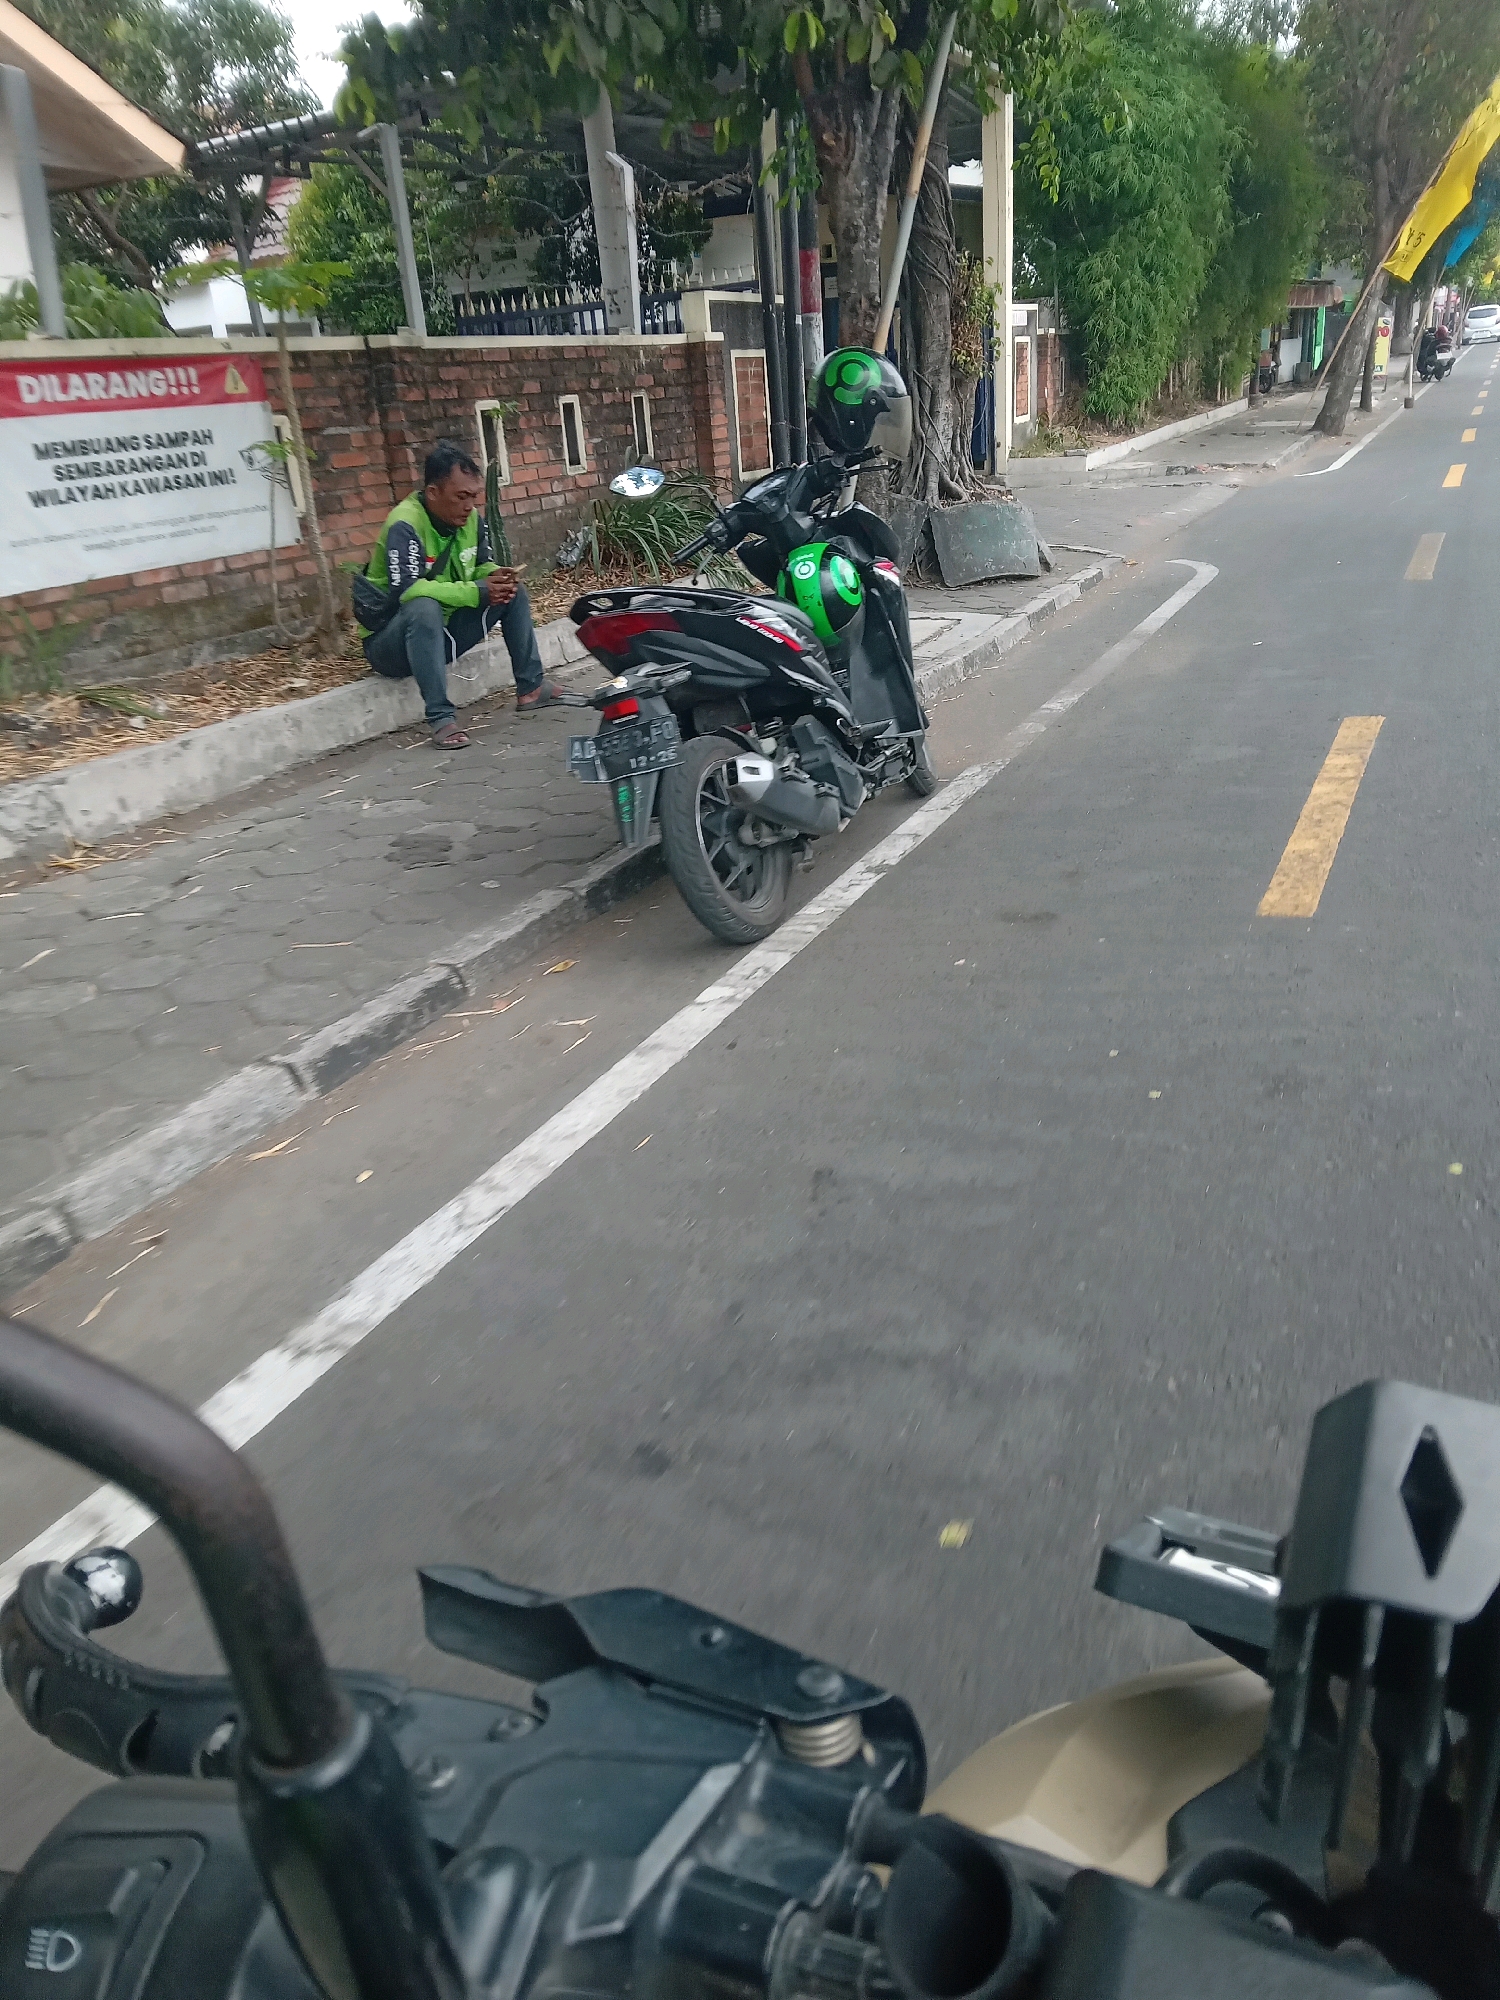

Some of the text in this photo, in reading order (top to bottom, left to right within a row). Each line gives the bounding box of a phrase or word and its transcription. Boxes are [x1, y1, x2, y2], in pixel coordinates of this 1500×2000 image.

[16, 367, 200, 403] DILARANG!!!
[32, 429, 214, 460] MEMBUANG SAMPAH
[53, 450, 208, 482] SEMBARANGAN DI
[27, 484, 118, 508] WILAYAH
[119, 473, 206, 498] KAWASAN
